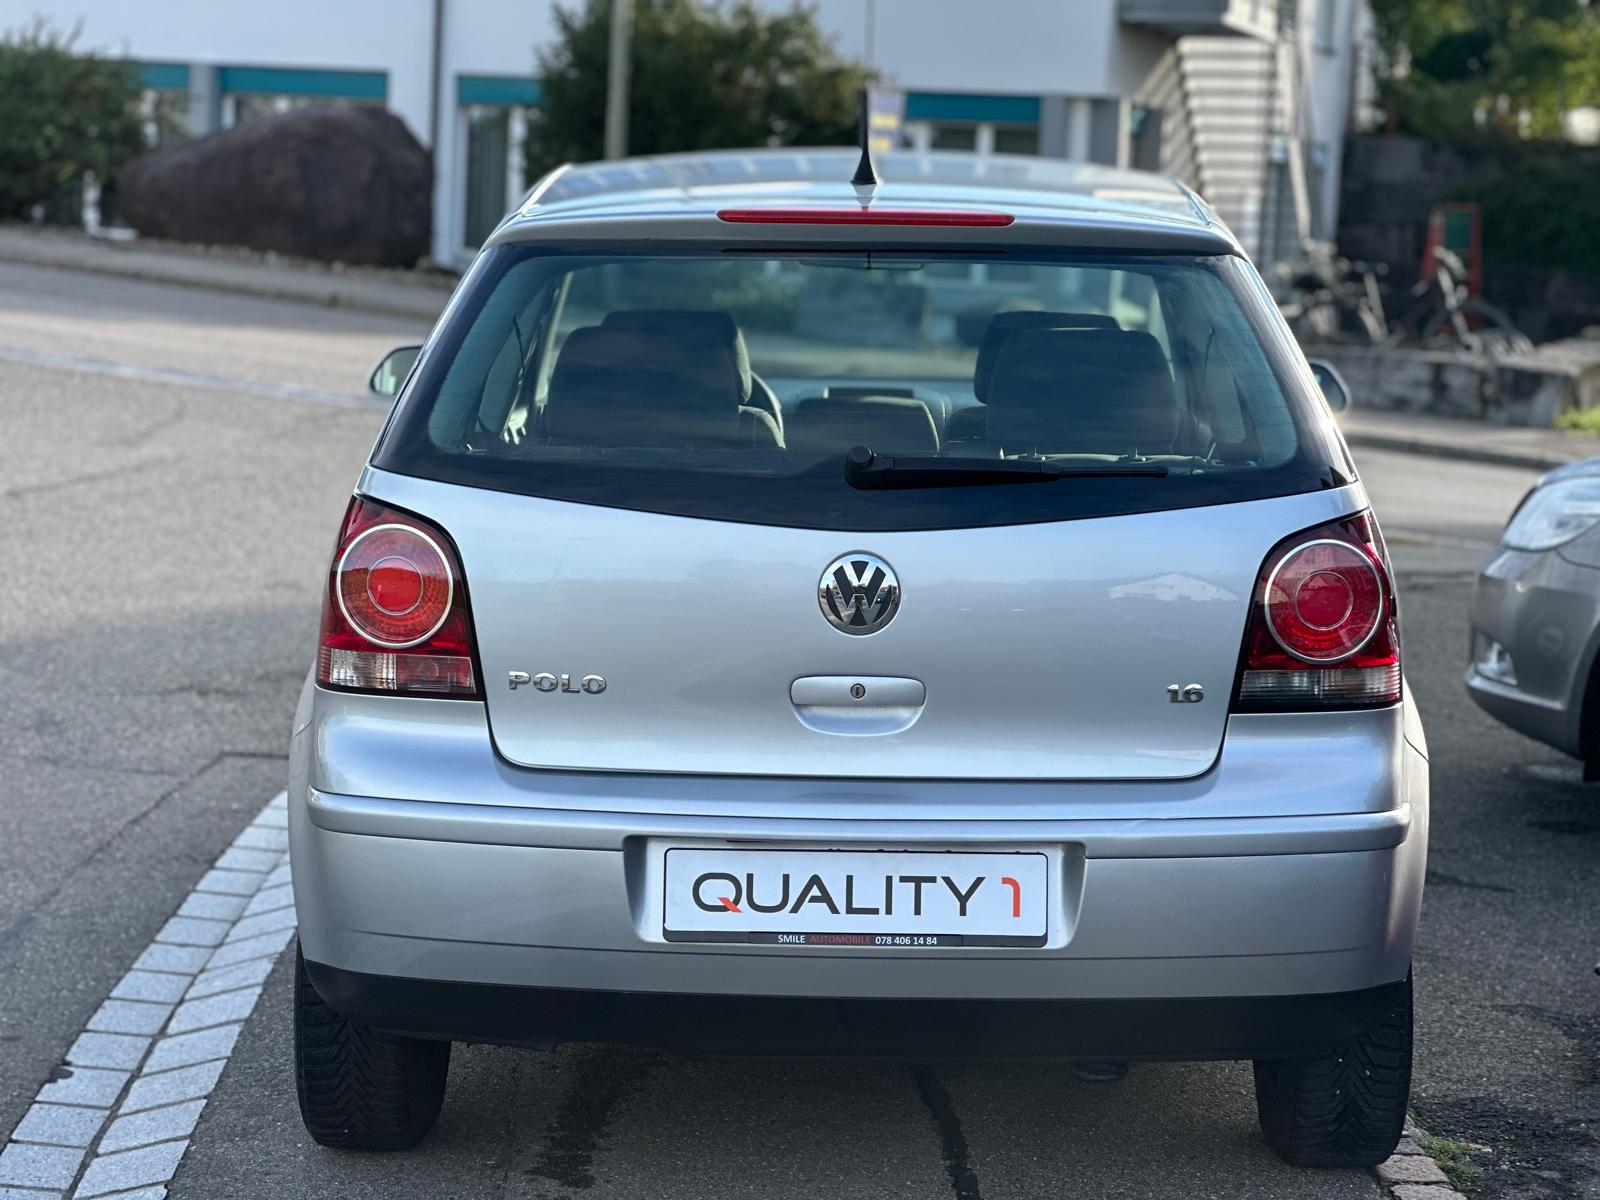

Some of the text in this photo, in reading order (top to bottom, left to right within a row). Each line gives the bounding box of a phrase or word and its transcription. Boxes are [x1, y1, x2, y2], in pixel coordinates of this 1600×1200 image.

[508, 670, 607, 695] POLO
[692, 872, 1021, 918] QUALITY 1
[778, 934, 938, 946] SMILE AUTOMOBILE 078 406 14 84
